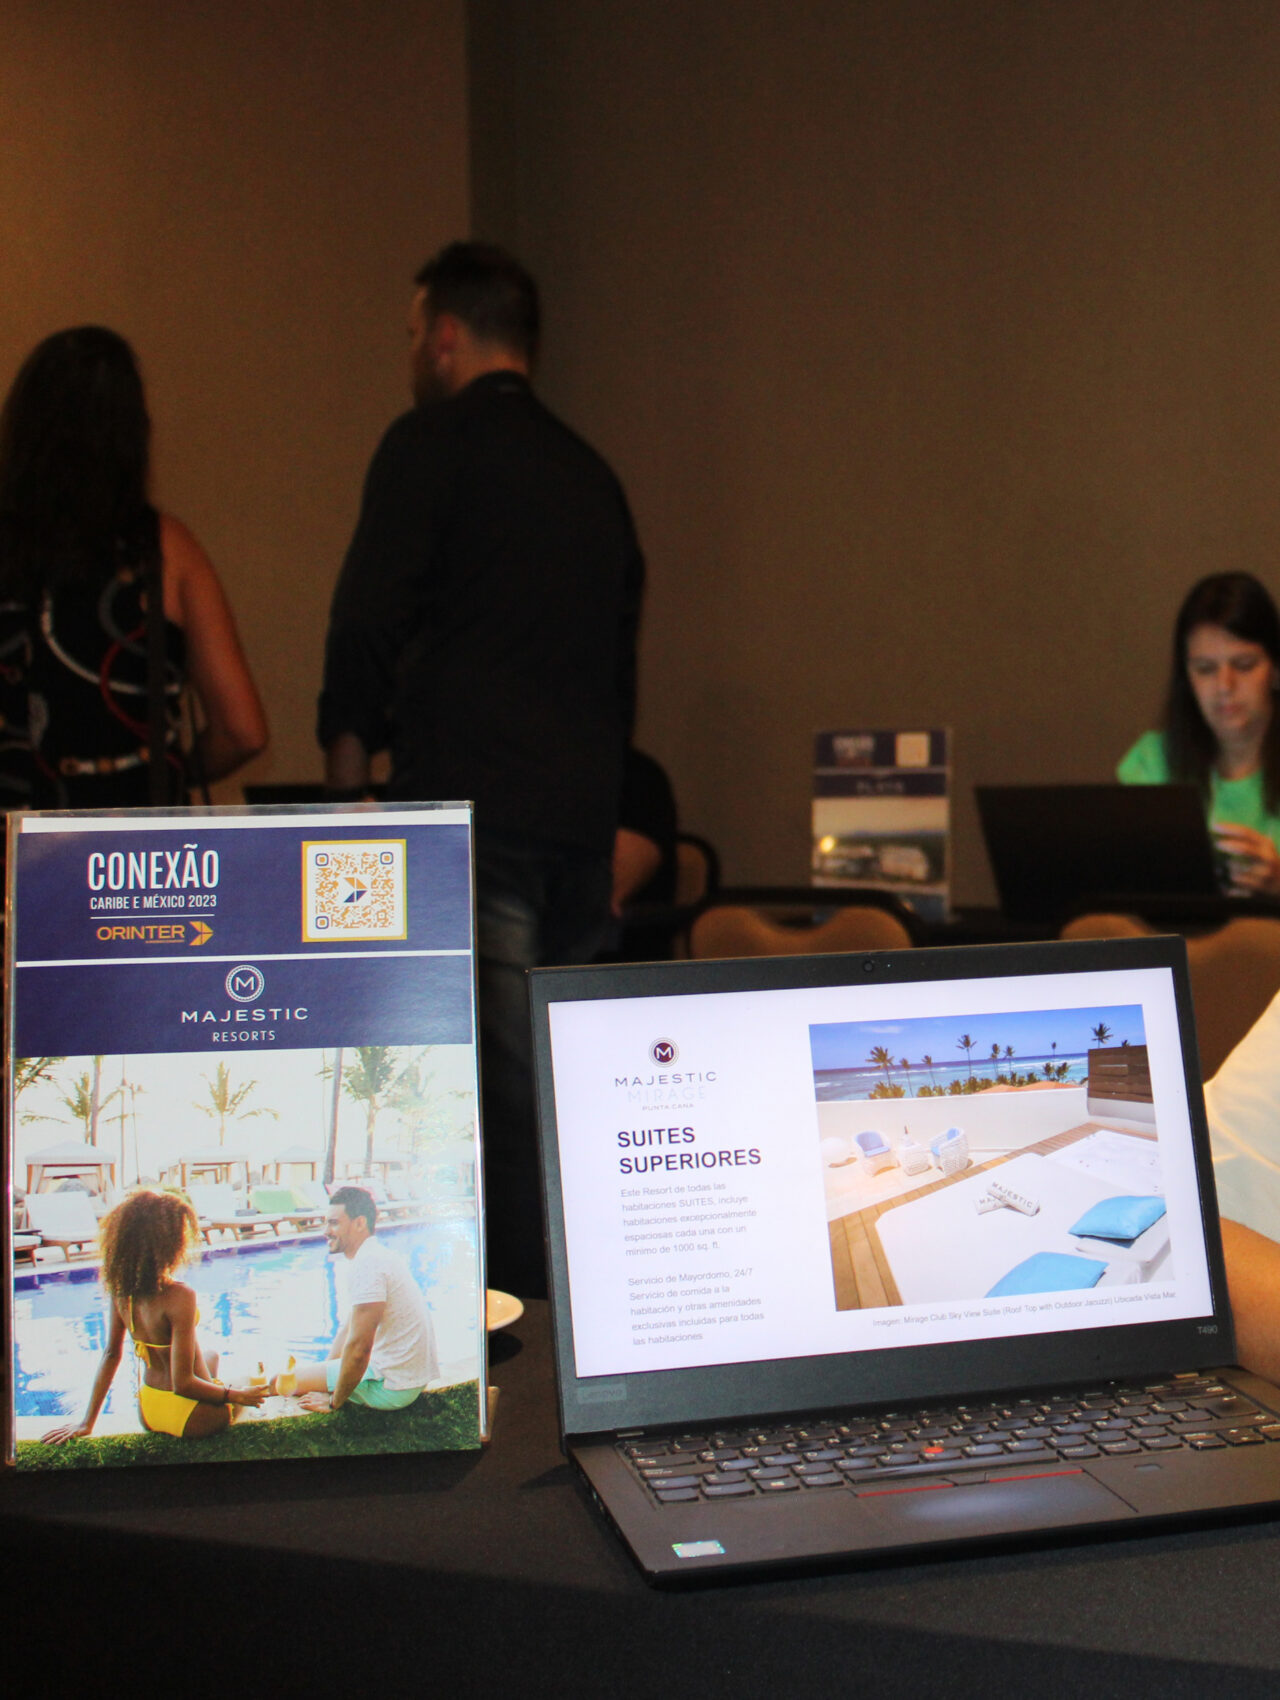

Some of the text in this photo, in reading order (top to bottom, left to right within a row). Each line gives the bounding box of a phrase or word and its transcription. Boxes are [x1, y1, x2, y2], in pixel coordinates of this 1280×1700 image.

[88, 844, 220, 891] CONEXÃO
[90, 894, 217, 910] CARIBE E MÉXICO 2023
[97, 924, 185, 941] ORINTER
[182, 1007, 309, 1024] MAJESTIC
[213, 1030, 276, 1043] RESORTS
[615, 1071, 717, 1087] MAJESTIC
[627, 1086, 706, 1103] MIRAGE
[617, 1127, 695, 1148] SUITES
[619, 1148, 761, 1174] SUPERIORES
[621, 1182, 726, 1198] Este Resort de todas las
[622, 1199, 677, 1212] habitaciones
[718, 1195, 748, 1206] incluye
[623, 1209, 757, 1227] habitaciones excepcionalmente
[625, 1225, 746, 1242] espaciosas cada una con un
[659, 1244, 671, 1254] de
[673, 1242, 694, 1253] 1000
[628, 1275, 663, 1286] Servicio
[665, 1274, 677, 1284] de
[734, 1268, 753, 1278] 24/7
[630, 1290, 664, 1301] Servicio
[667, 1289, 678, 1298] de
[680, 1286, 712, 1297] comida
[722, 1285, 730, 1293] la
[677, 1304, 683, 1313] y
[685, 1301, 707, 1311] otras
[709, 1297, 761, 1309] amenidades
[904, 1314, 928, 1325] Mirage
[930, 1311, 947, 1322] Club
[949, 1310, 962, 1321] Sky
[1054, 1300, 1082, 1310] Outdoor
[632, 1312, 764, 1331] exclusivas incluidas para todas
[633, 1332, 703, 1346] las habitaciones
